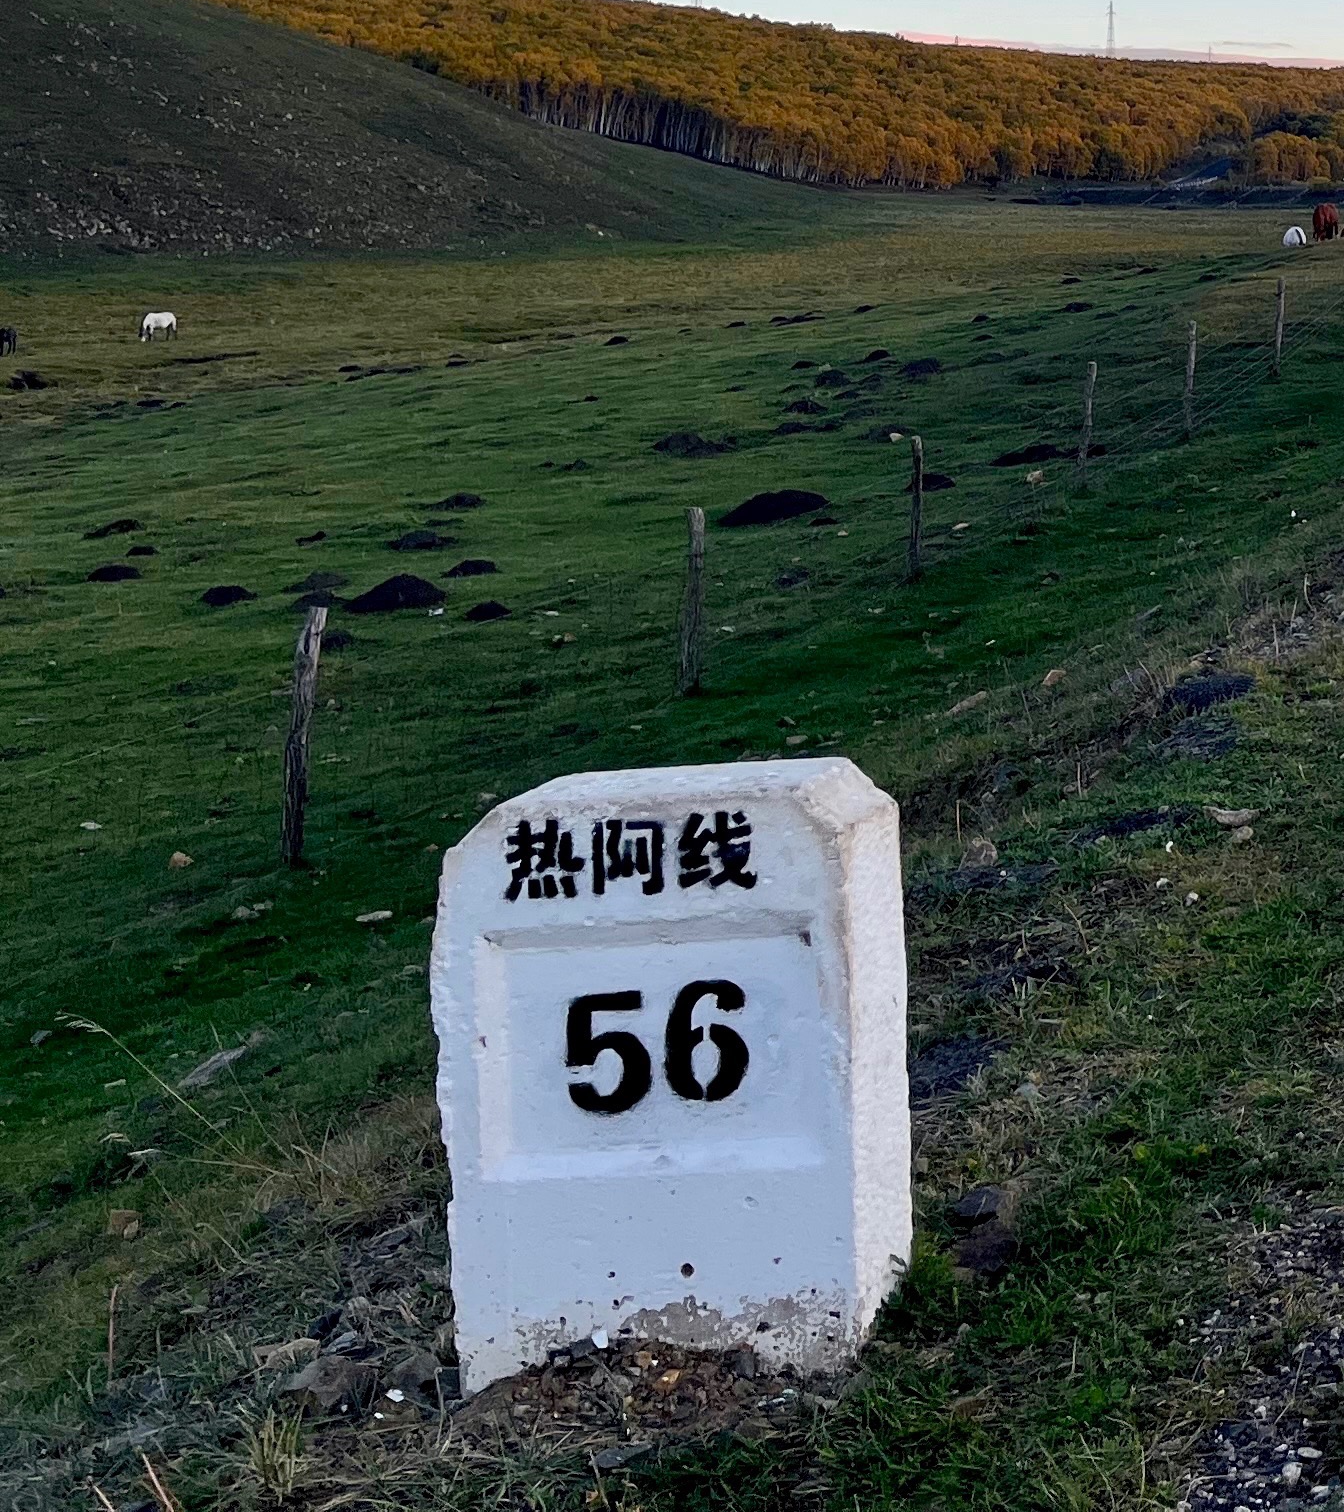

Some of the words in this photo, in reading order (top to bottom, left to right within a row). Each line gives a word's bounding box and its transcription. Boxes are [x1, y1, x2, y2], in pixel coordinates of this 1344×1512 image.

[503, 810, 757, 903] 热阿线
[565, 979, 750, 1114] 56
